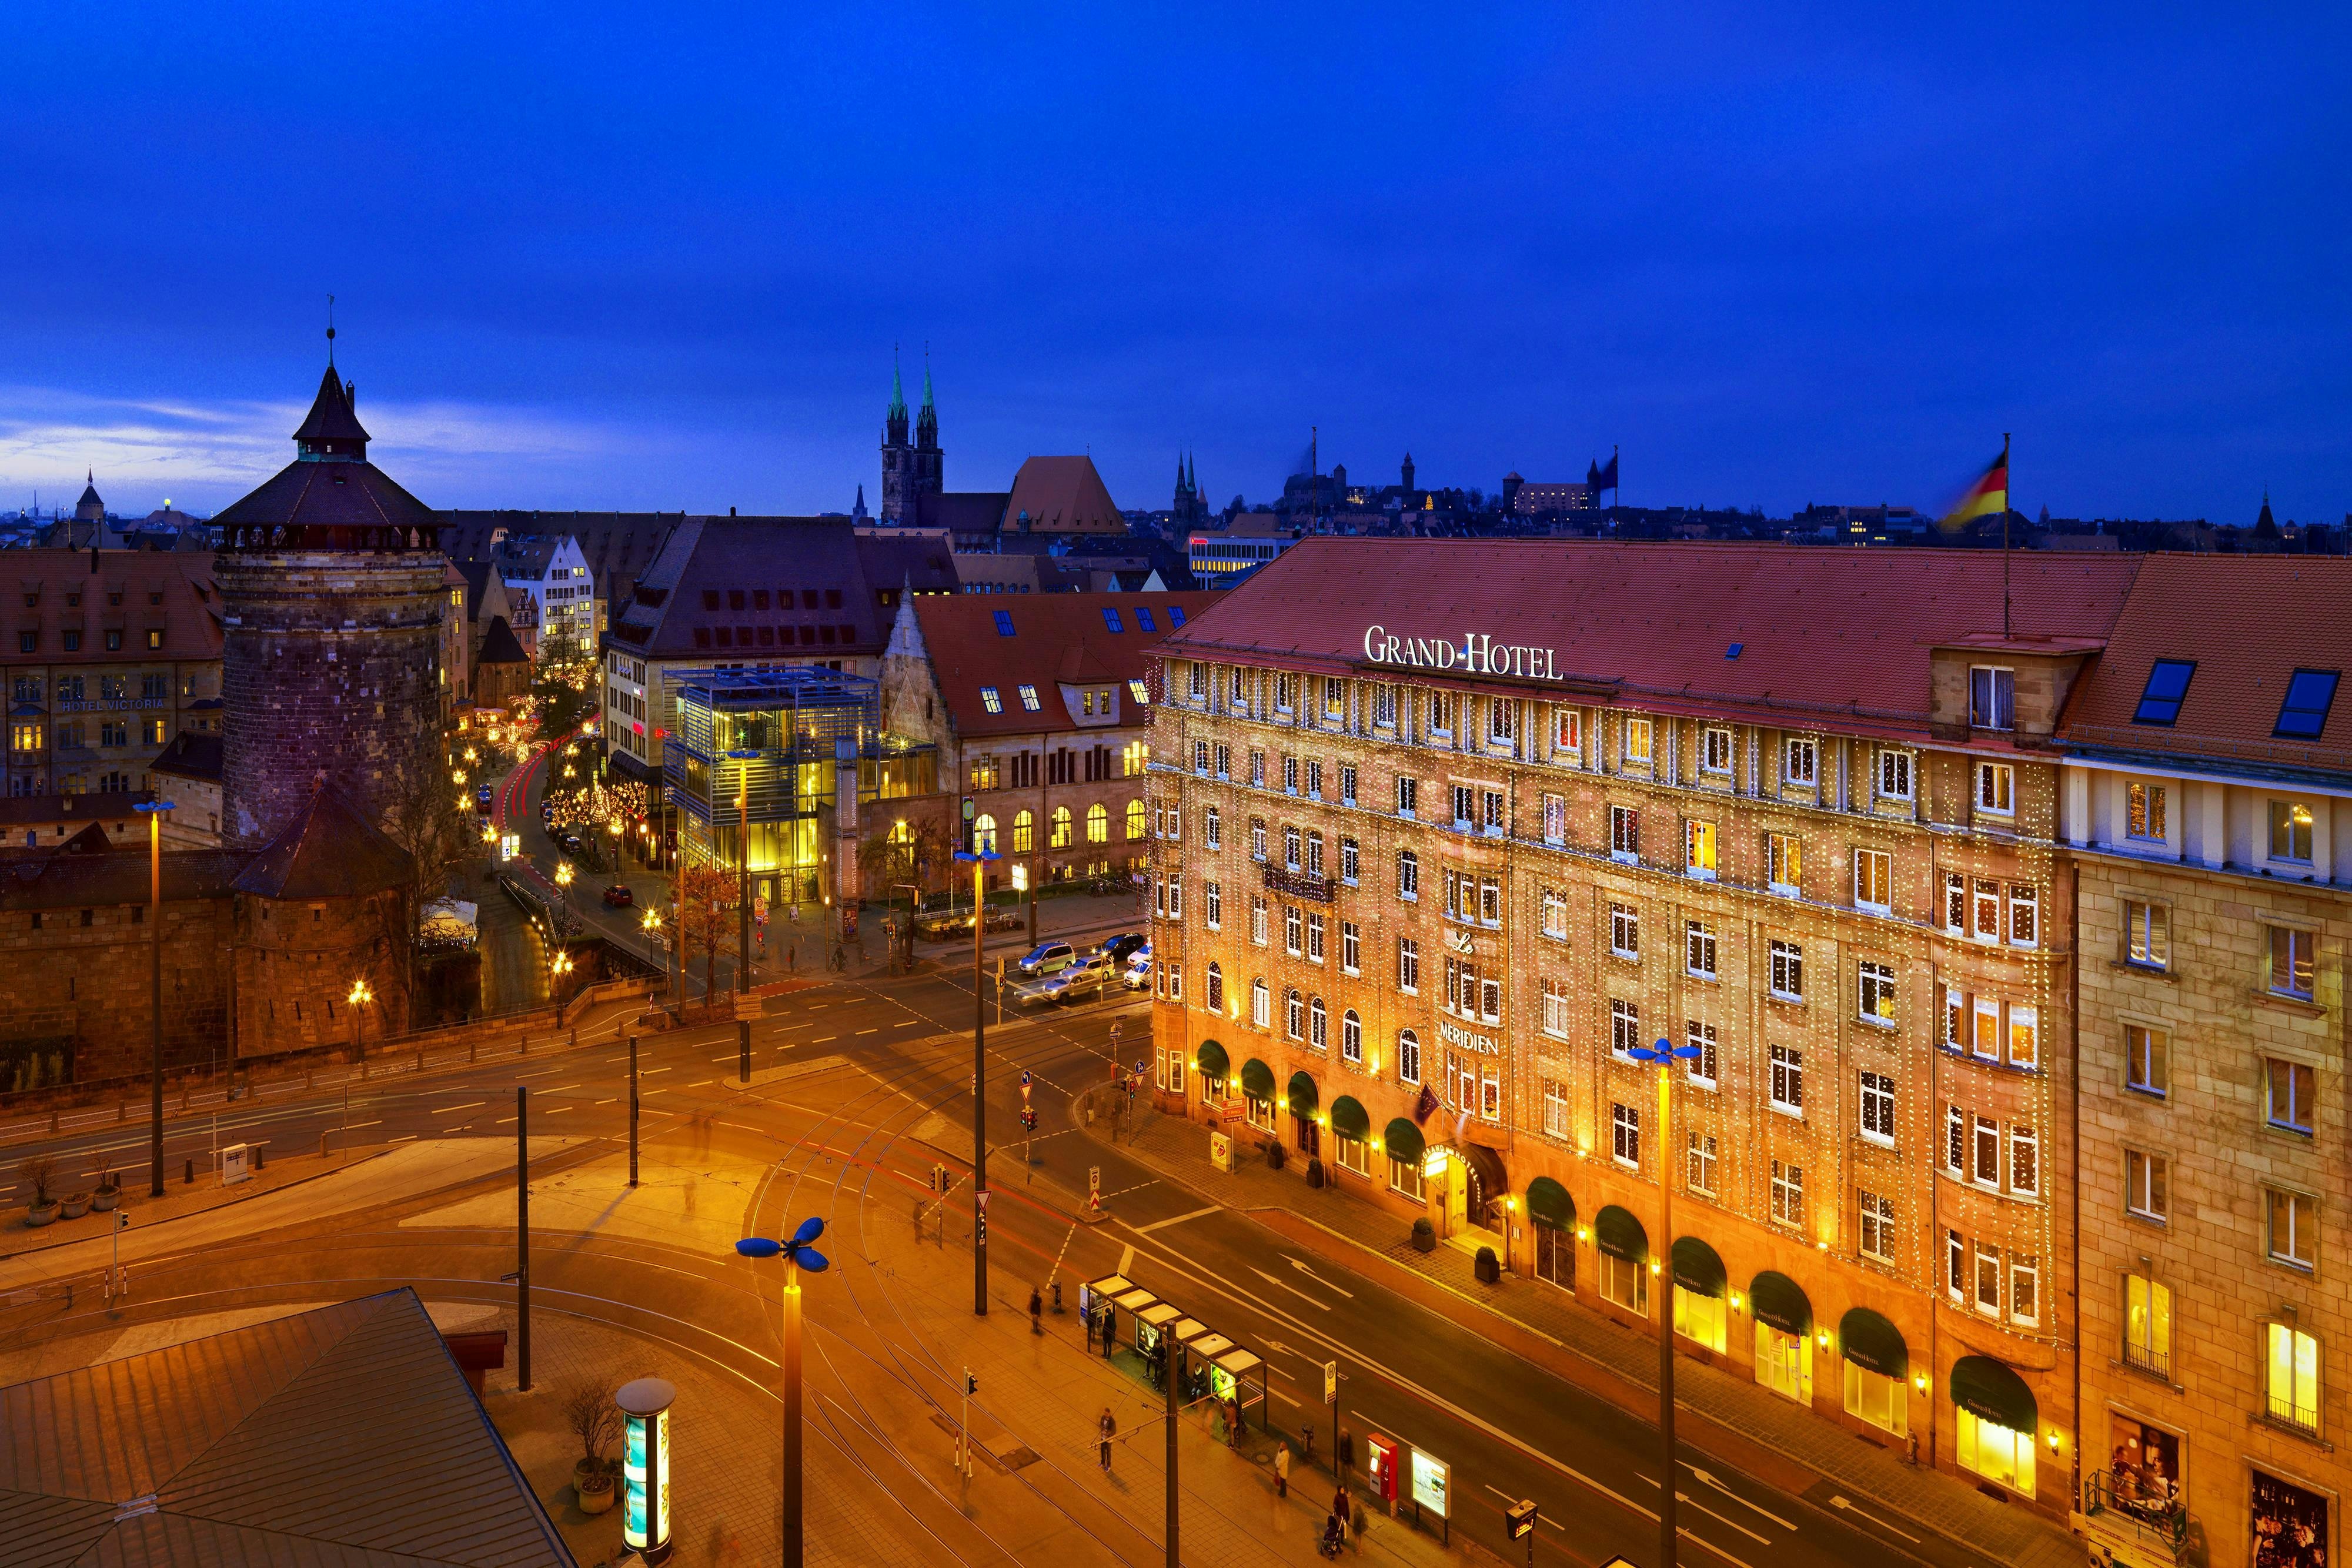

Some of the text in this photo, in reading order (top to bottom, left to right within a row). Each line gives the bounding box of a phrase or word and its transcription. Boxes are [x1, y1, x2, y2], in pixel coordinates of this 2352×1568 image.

[62, 698, 164, 712] HOTEL VICTORIA
[1440, 1021, 1499, 1055] MERIDIEN
[1422, 1144, 1478, 1182] GRAND HOTEL
